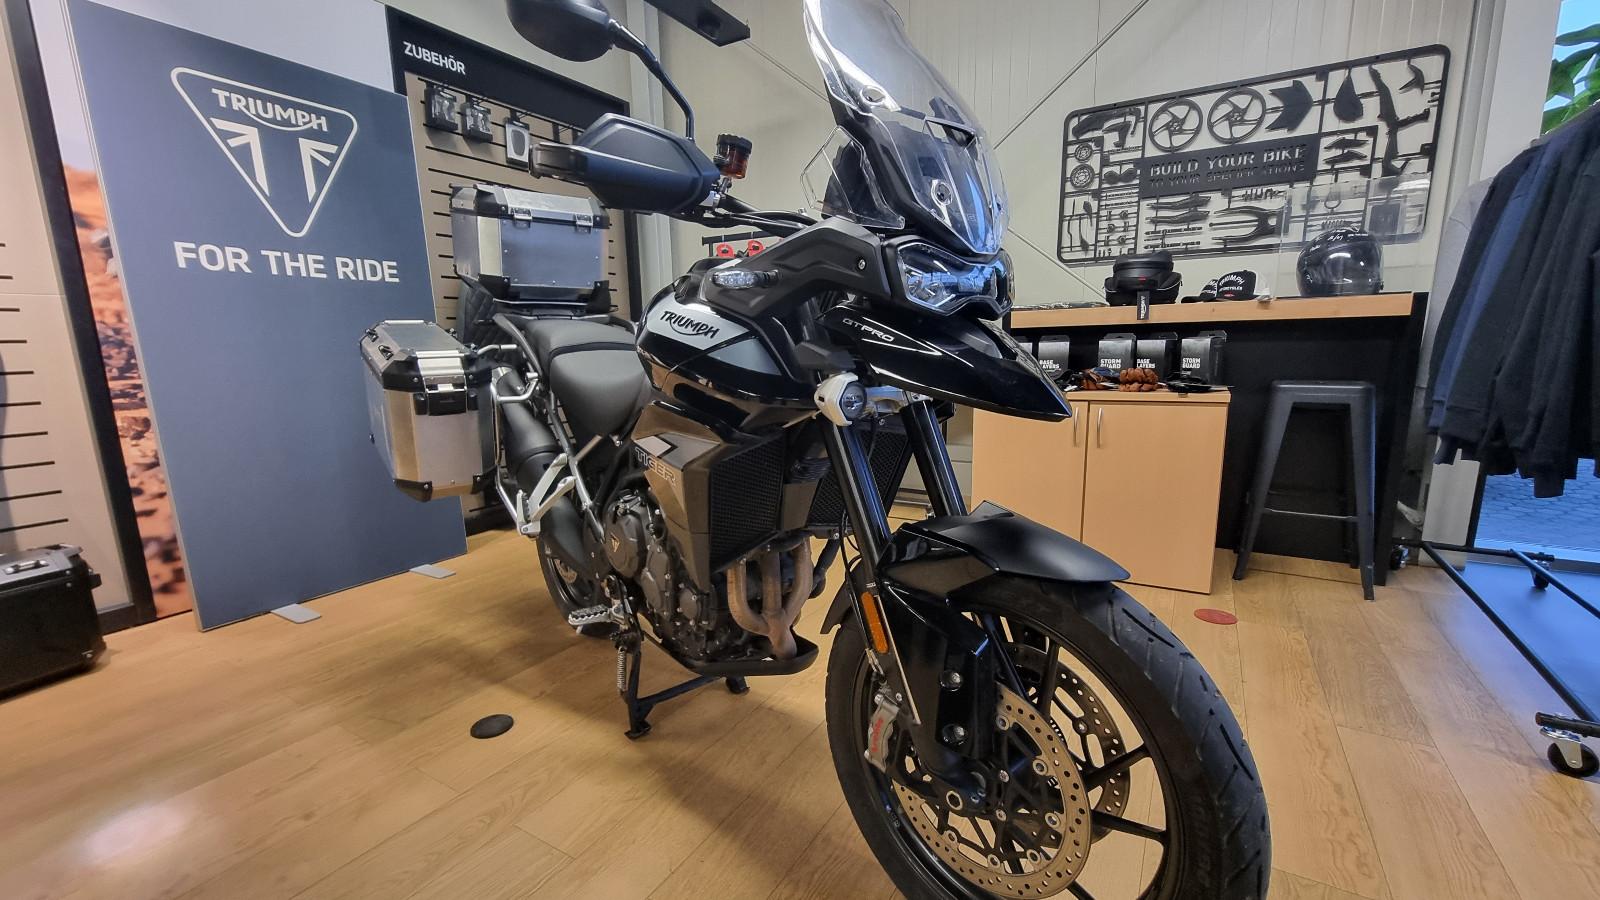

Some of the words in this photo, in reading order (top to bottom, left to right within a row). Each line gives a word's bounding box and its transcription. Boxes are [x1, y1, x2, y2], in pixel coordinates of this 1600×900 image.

[403, 40, 466, 75] ZUBEHÖR
[211, 88, 329, 132] TRIUMPH
[1150, 158, 1199, 177] BUILD
[1206, 152, 1255, 170] YOUR
[1263, 143, 1307, 163] BIKE
[173, 241, 253, 273] FOR
[261, 249, 327, 279] THE
[335, 256, 400, 283] RIDE
[660, 310, 720, 339] TRIUMPH
[635, 446, 676, 486] TIGER
